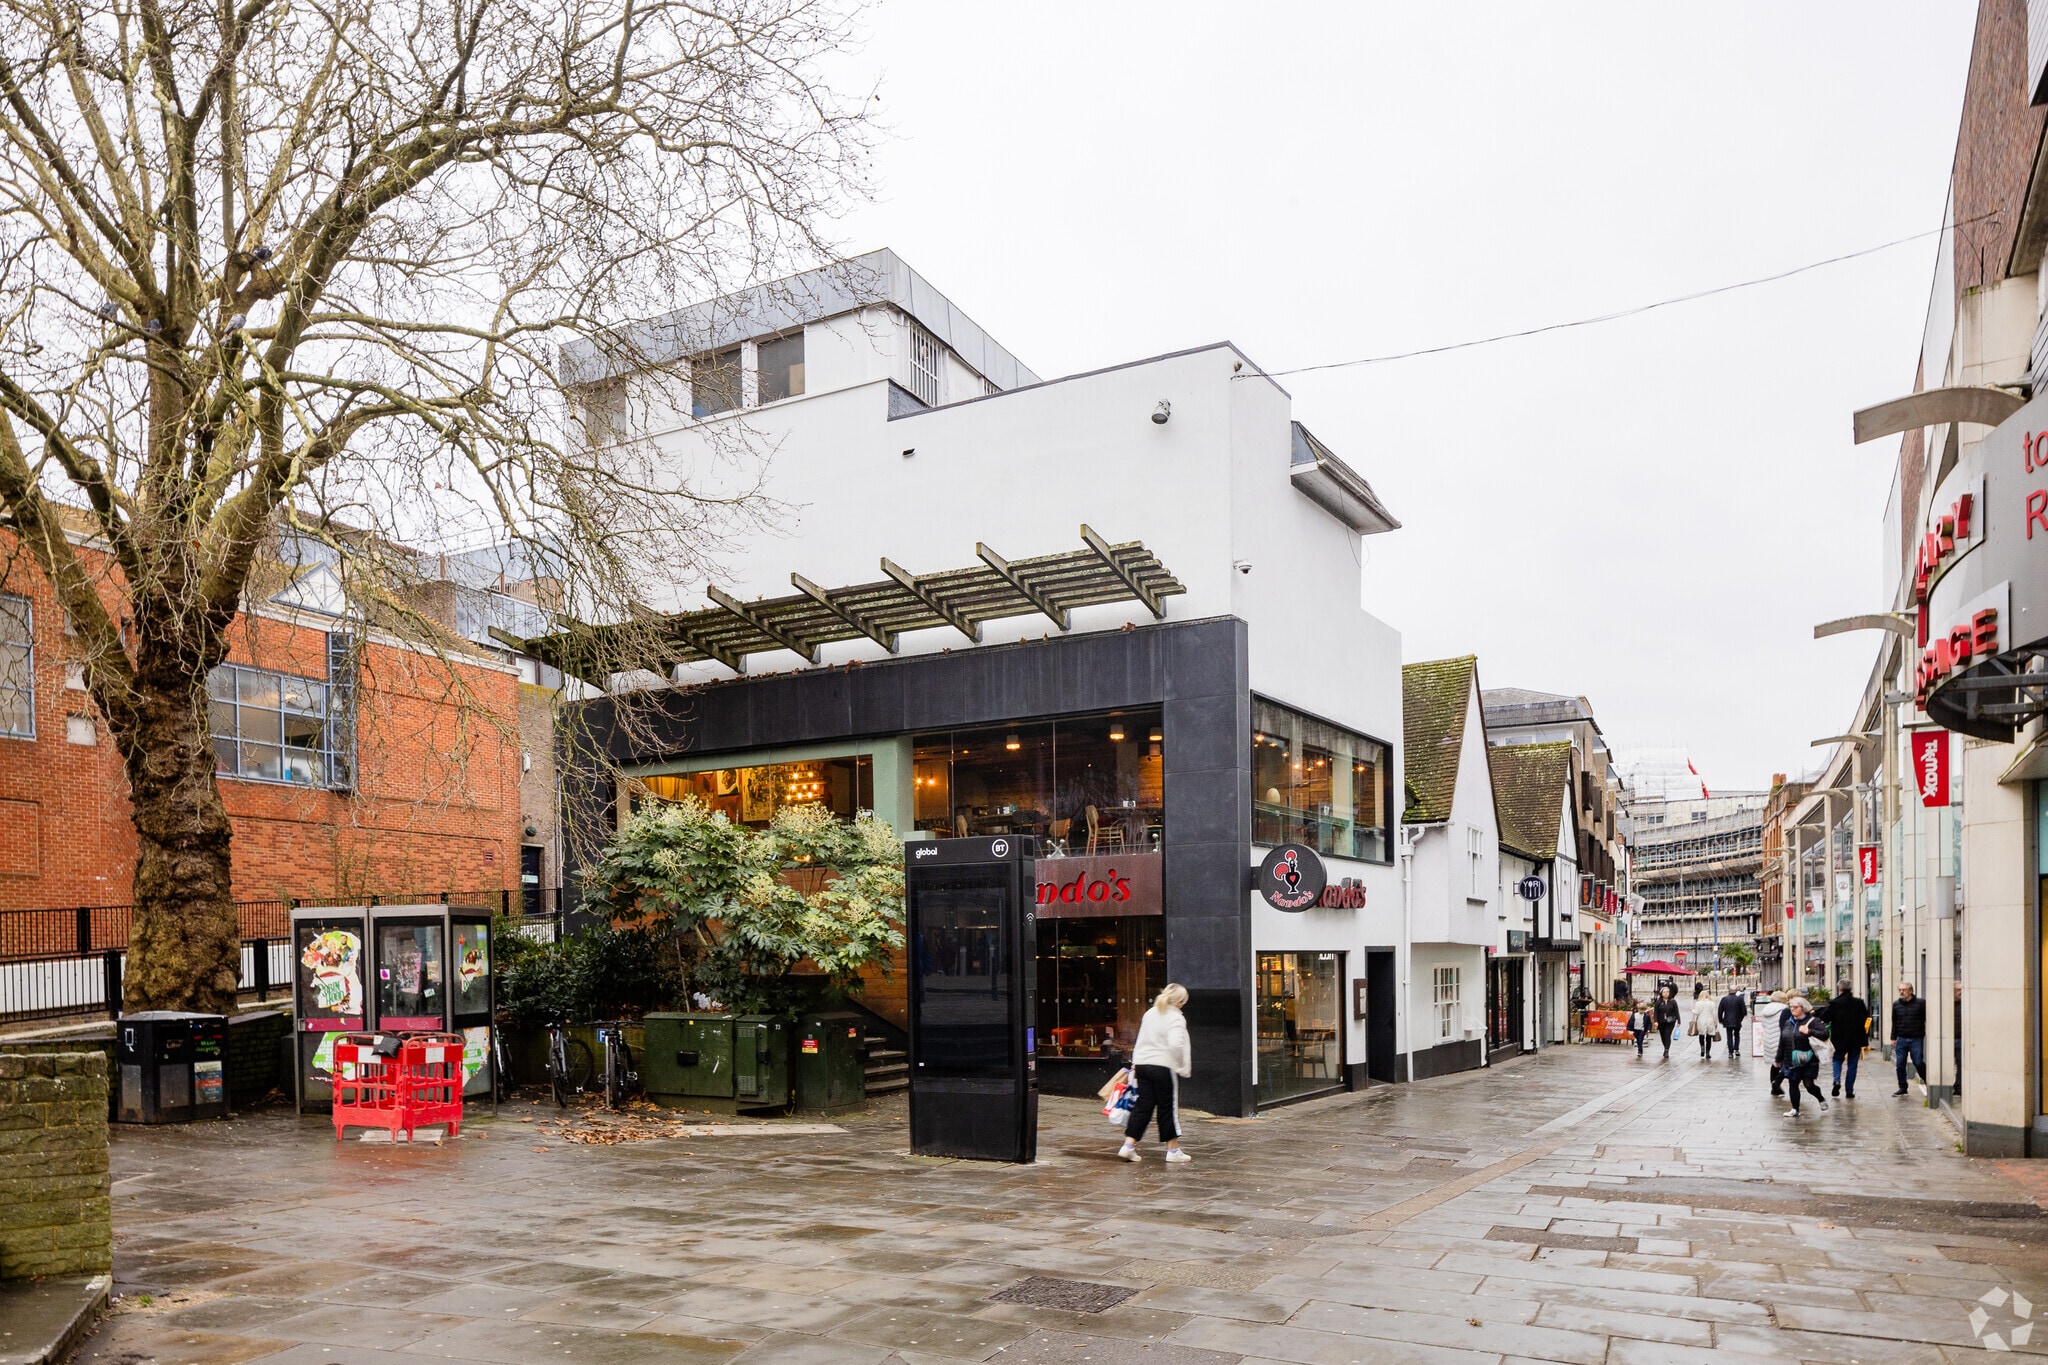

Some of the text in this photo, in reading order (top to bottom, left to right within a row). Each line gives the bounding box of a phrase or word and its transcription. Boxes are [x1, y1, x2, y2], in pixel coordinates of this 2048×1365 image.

[915, 847, 938, 859] global
[995, 844, 1005, 852] BT
[1270, 890, 1314, 908] Nando's
[1315, 877, 1367, 909] ando's
